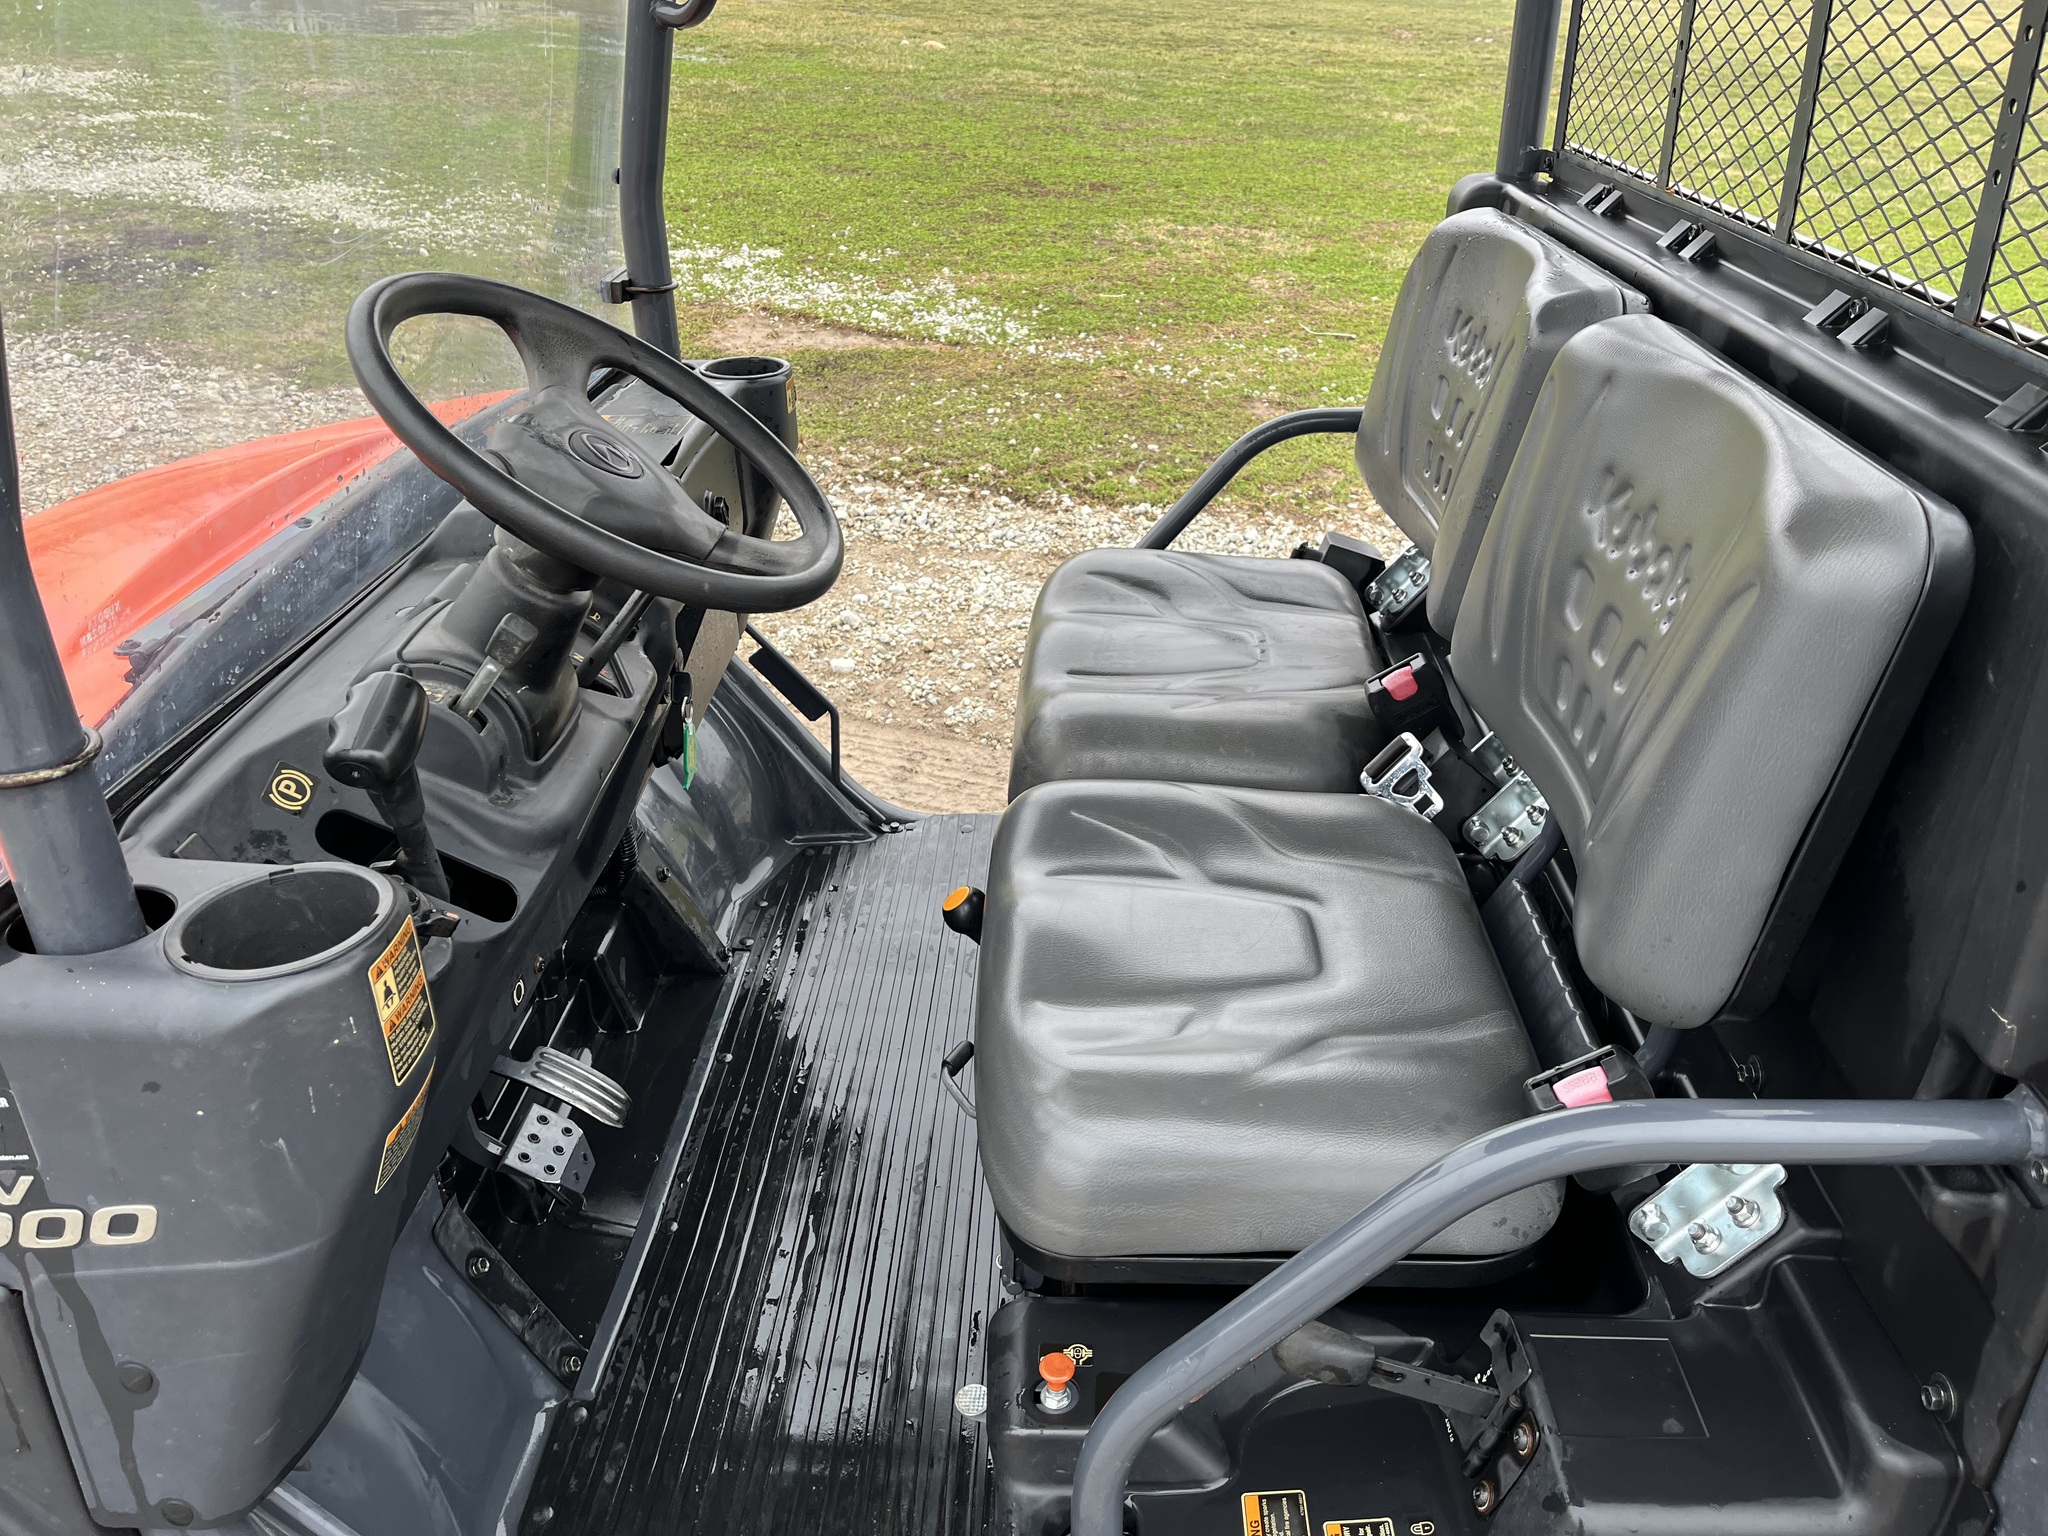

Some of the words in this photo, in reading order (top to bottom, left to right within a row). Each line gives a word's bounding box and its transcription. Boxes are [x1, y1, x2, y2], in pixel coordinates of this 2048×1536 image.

[1581, 461, 1692, 636] Kubota
[381, 922, 412, 969] WARNING
[394, 974, 425, 1021] WARNING
[0, 1204, 158, 1249] 00
